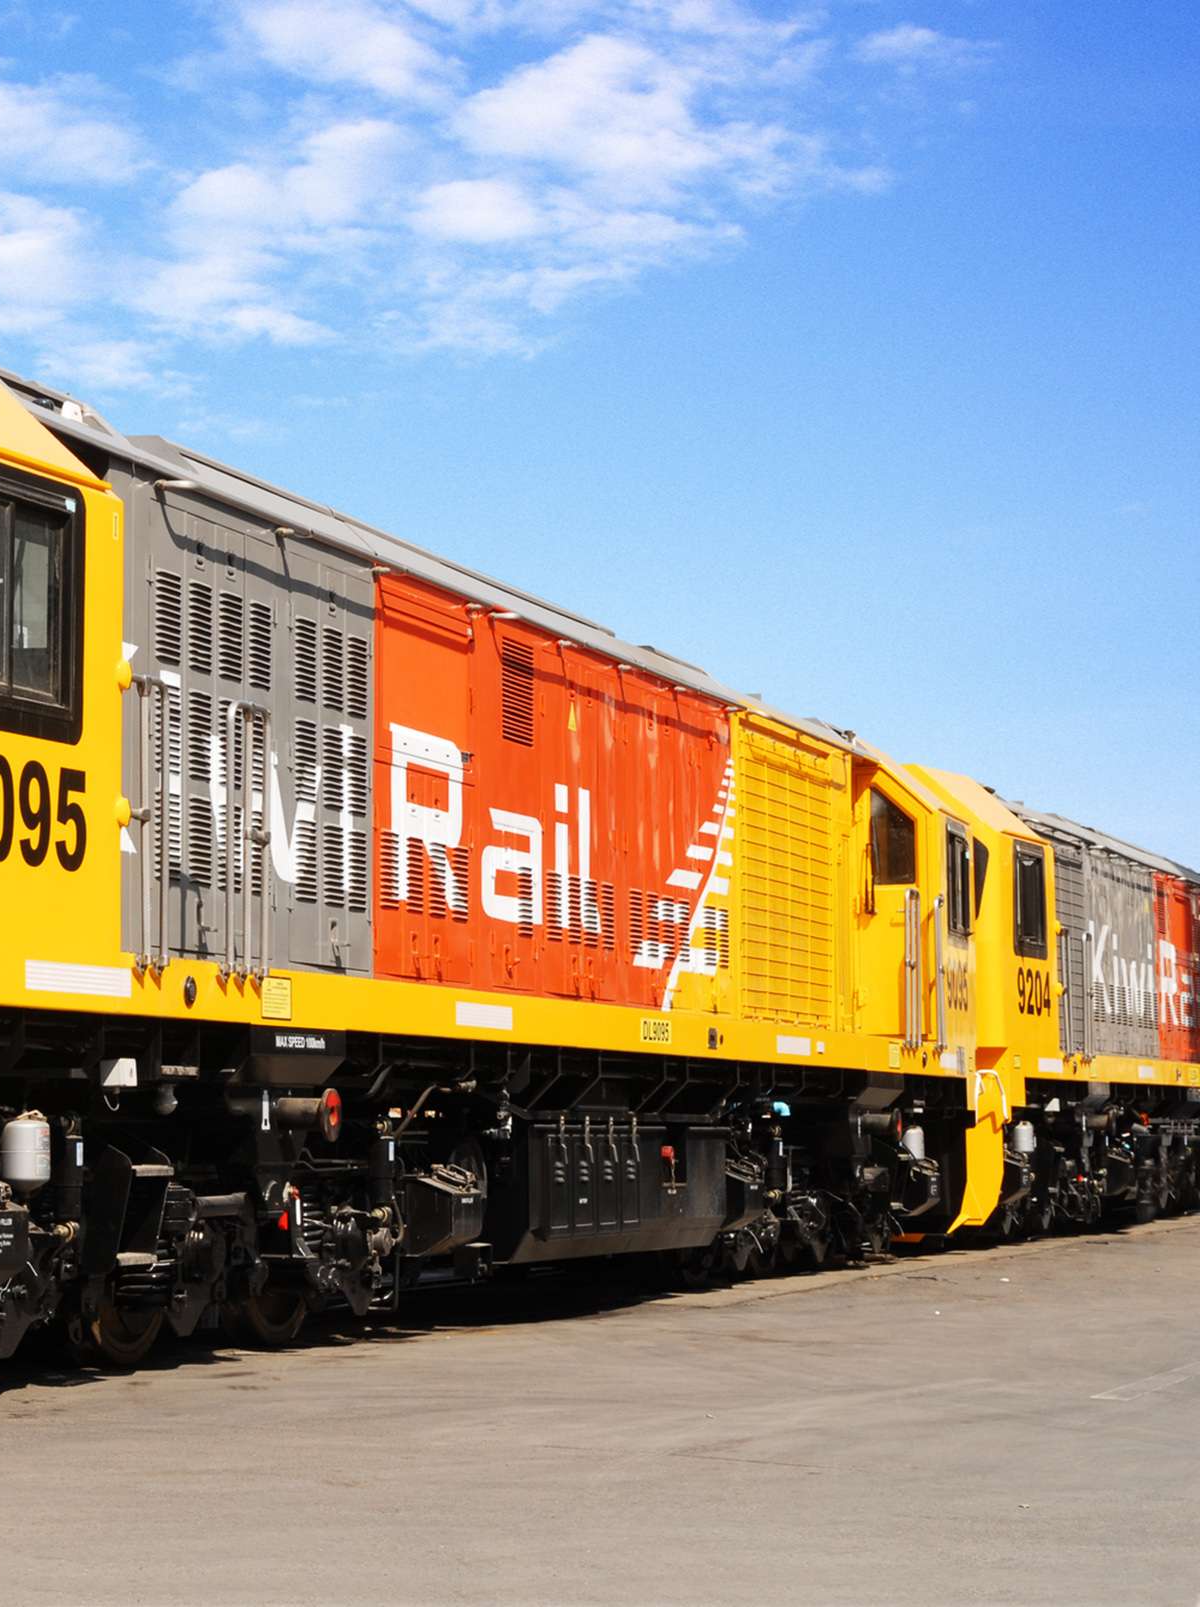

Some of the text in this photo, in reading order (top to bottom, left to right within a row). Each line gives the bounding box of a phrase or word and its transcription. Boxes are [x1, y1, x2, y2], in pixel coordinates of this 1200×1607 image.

[1017, 966, 1051, 1017] 9204
[643, 1021, 669, 1041] DL9095
[288, 1036, 305, 1048] SPEED
